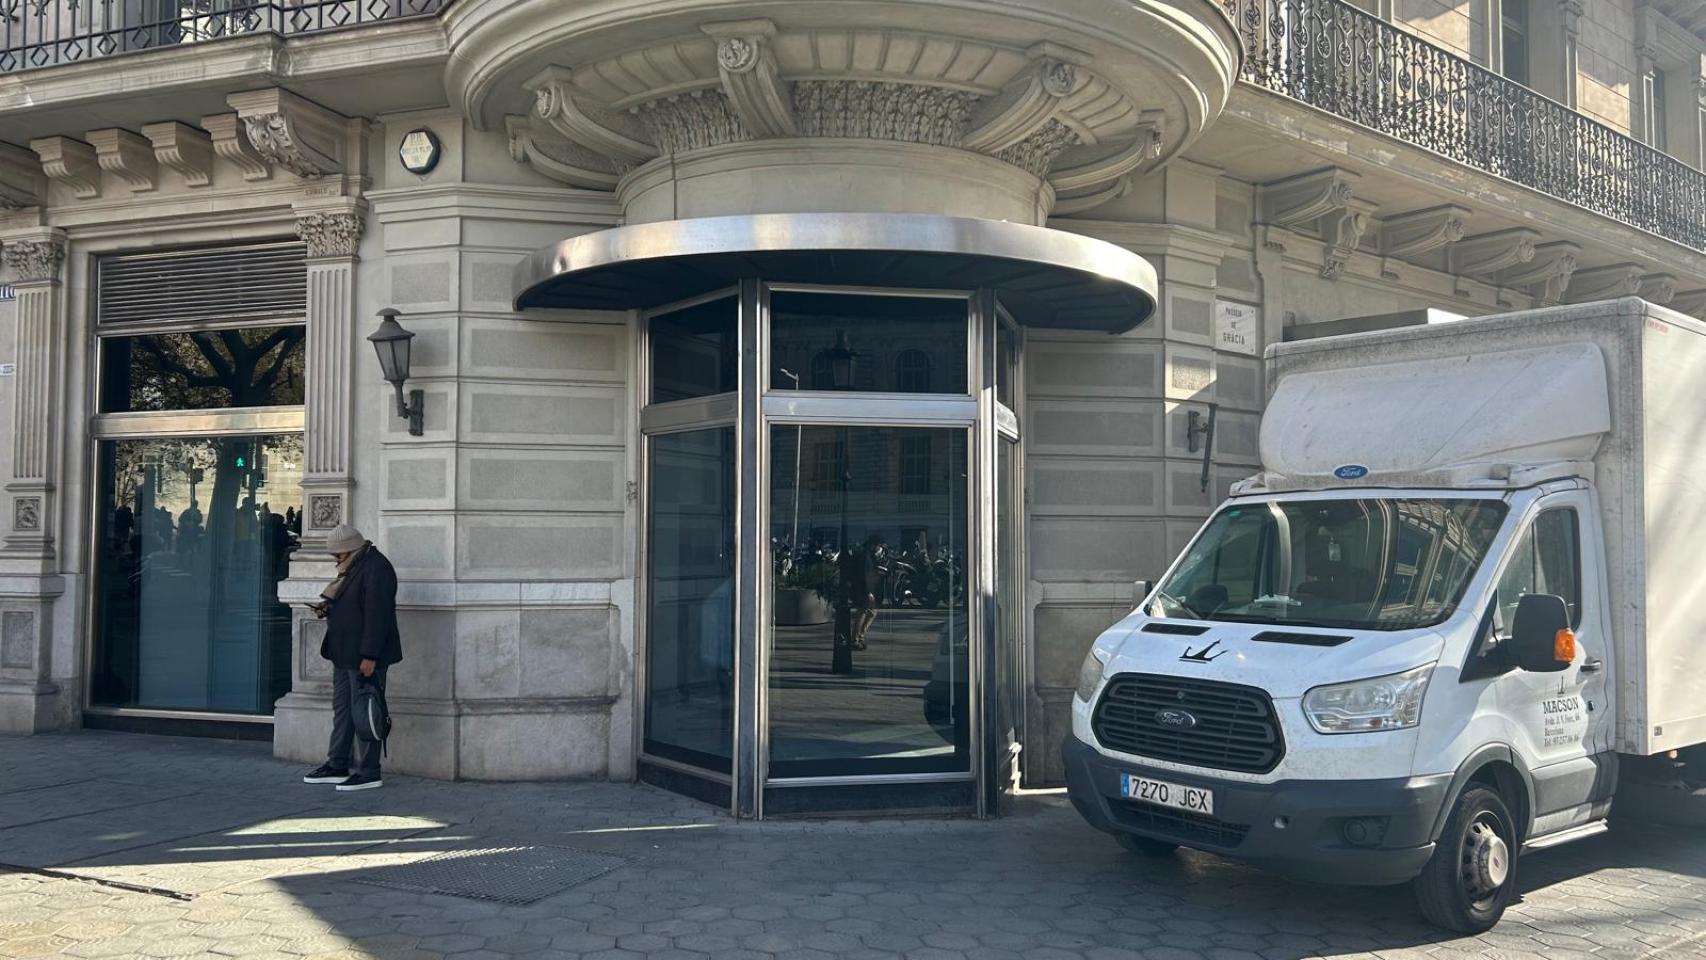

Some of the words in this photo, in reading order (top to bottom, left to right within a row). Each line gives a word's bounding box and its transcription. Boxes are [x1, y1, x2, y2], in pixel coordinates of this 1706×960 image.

[1340, 467, 1362, 477] Ford
[1543, 697, 1579, 714] MACSON
[1132, 778, 1169, 803] 7270
[1178, 788, 1208, 811] JCX
